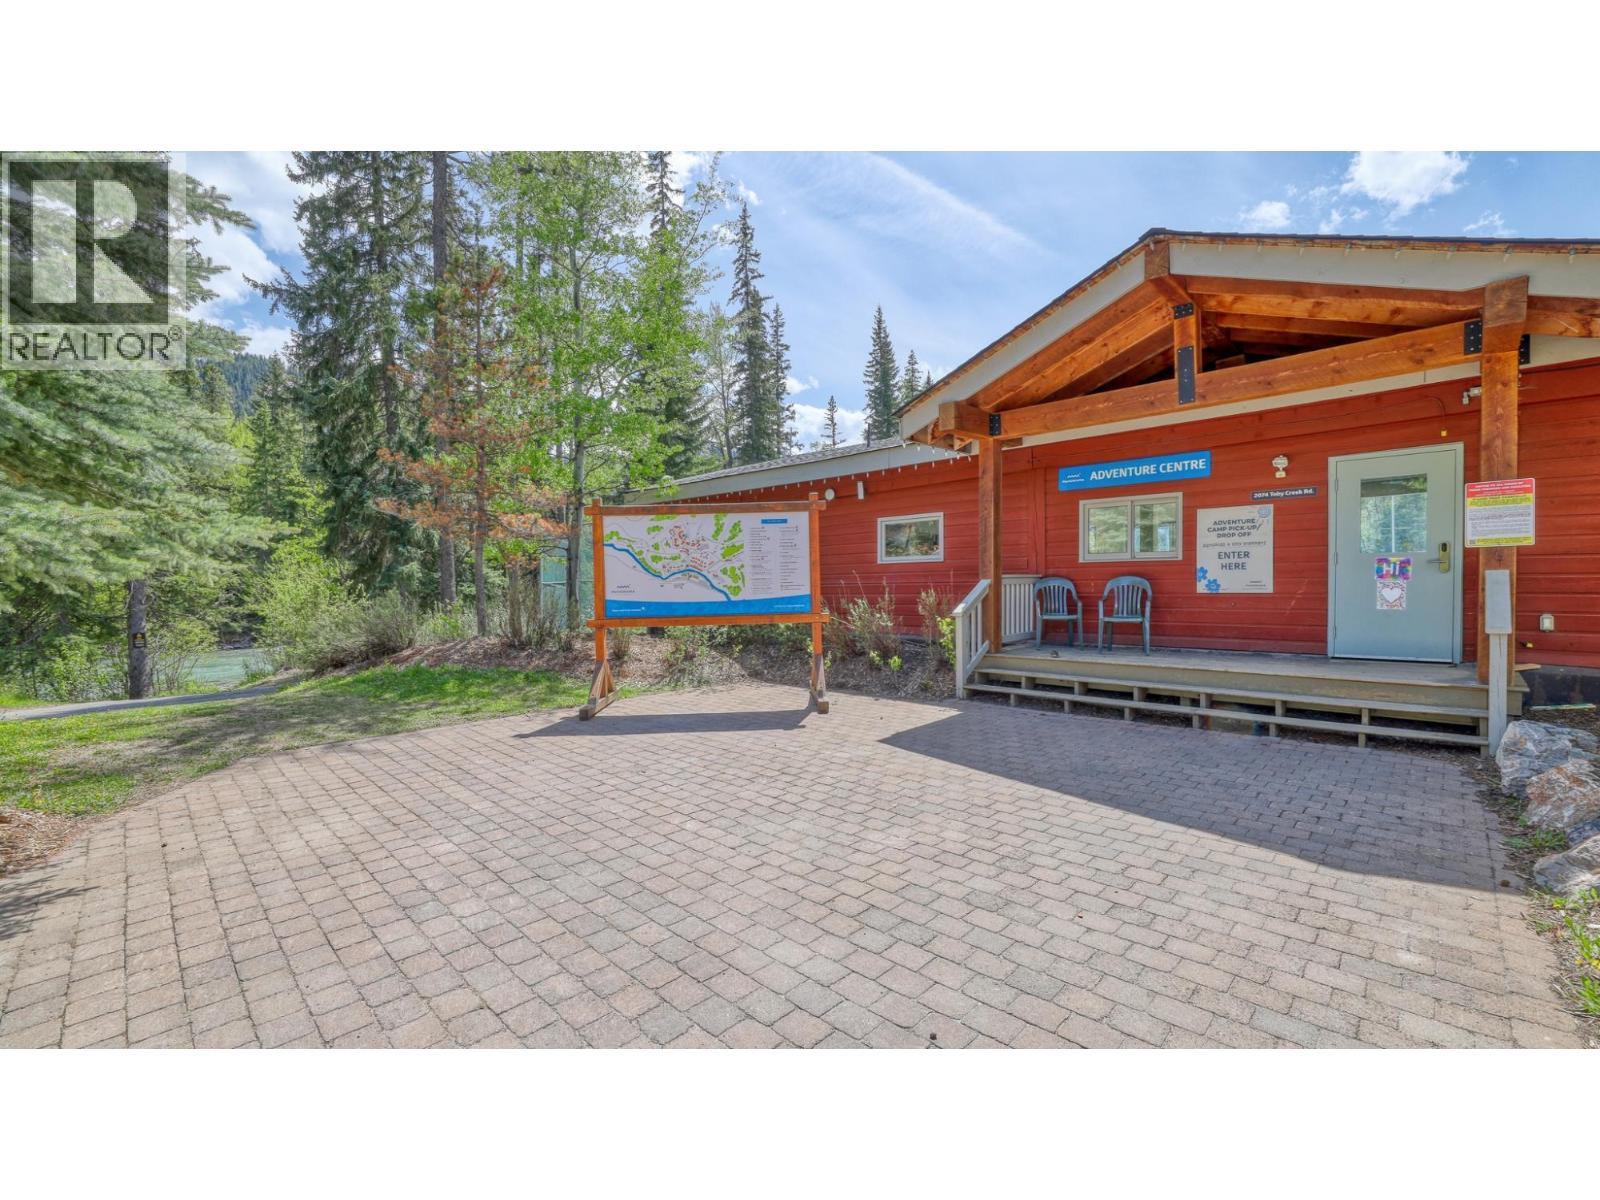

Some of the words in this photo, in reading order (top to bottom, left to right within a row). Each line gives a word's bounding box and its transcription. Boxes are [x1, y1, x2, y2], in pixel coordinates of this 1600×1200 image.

[1090, 464, 1157, 481] ADVENTURE
[1159, 458, 1206, 473] CENTRE
[1213, 518, 1256, 526] ADVENTURE
[1217, 551, 1250, 560] ENTER
[1220, 562, 1247, 570] HERE
